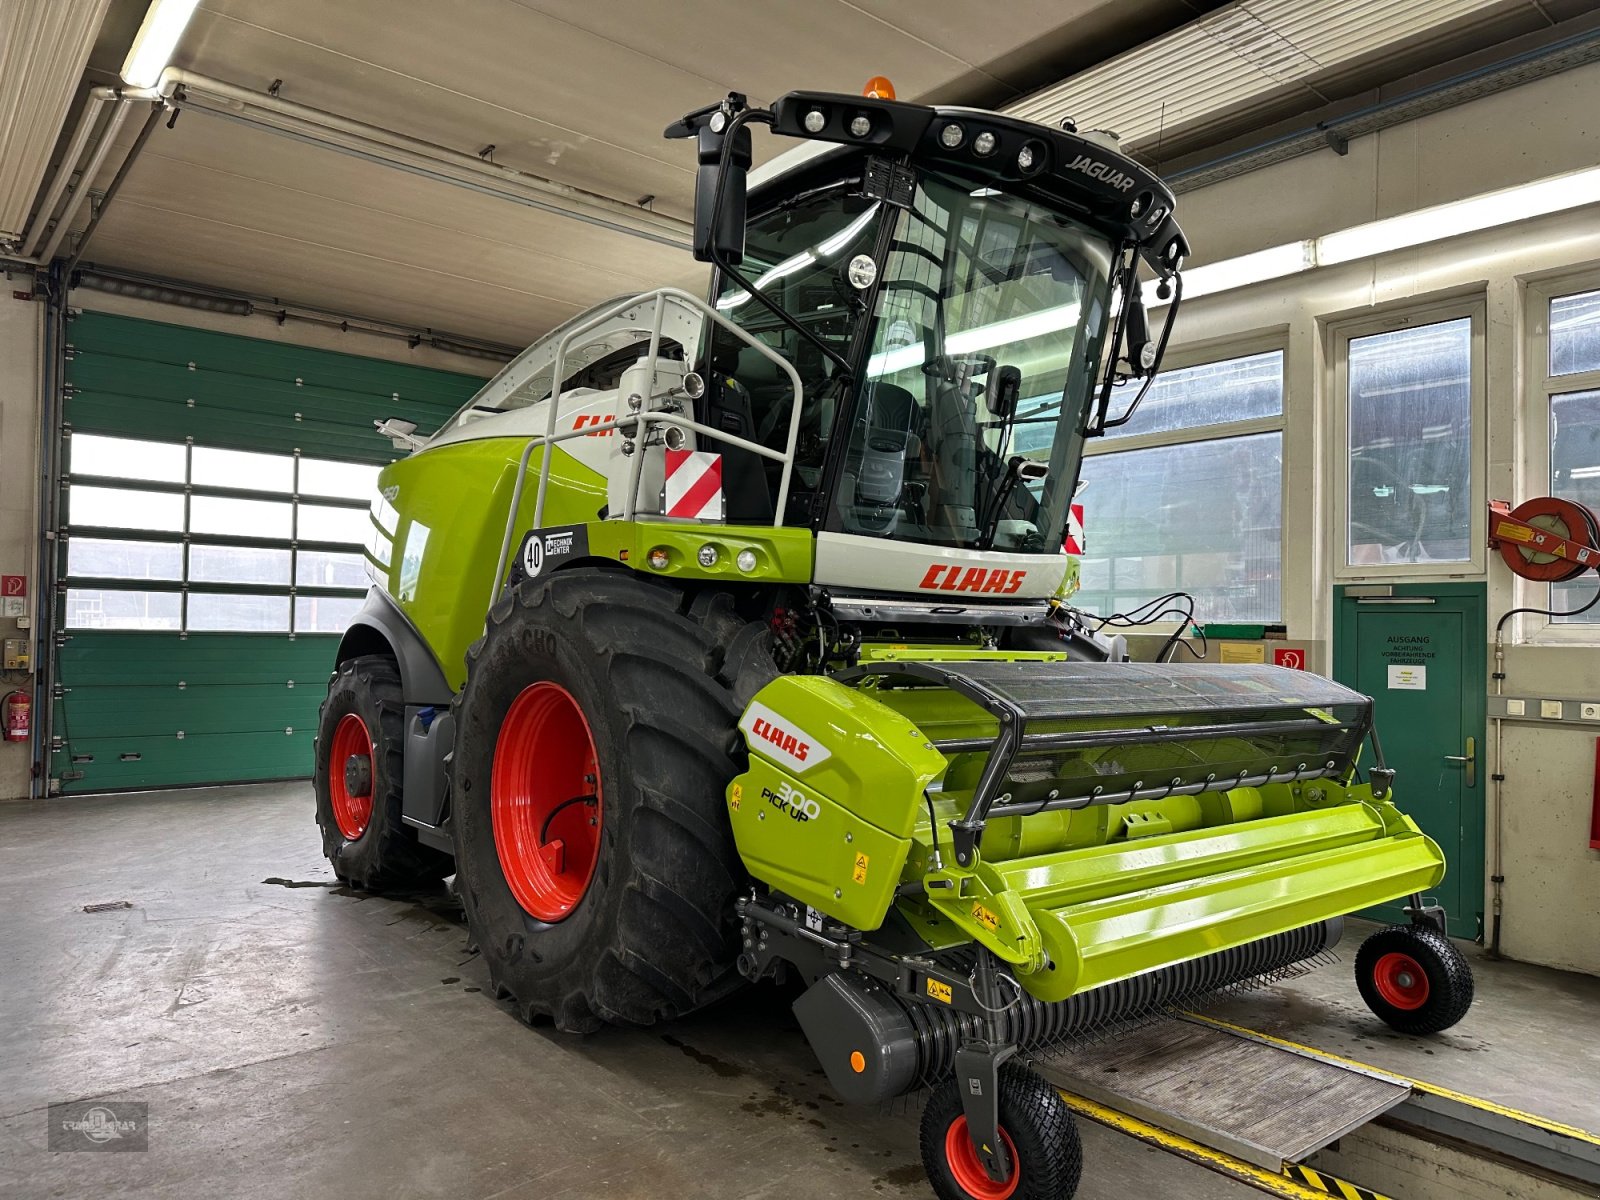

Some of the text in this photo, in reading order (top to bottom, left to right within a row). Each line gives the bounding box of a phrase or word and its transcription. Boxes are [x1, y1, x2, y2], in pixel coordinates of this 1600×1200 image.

[1065, 155, 1135, 193] JAGUAR
[527, 542, 540, 569] 40
[919, 564, 1027, 594] CLAAS
[1387, 636, 1430, 644] AUSGANG
[752, 718, 810, 762] CLAAS
[761, 787, 809, 822] PICK UP
[777, 781, 821, 820] 300
